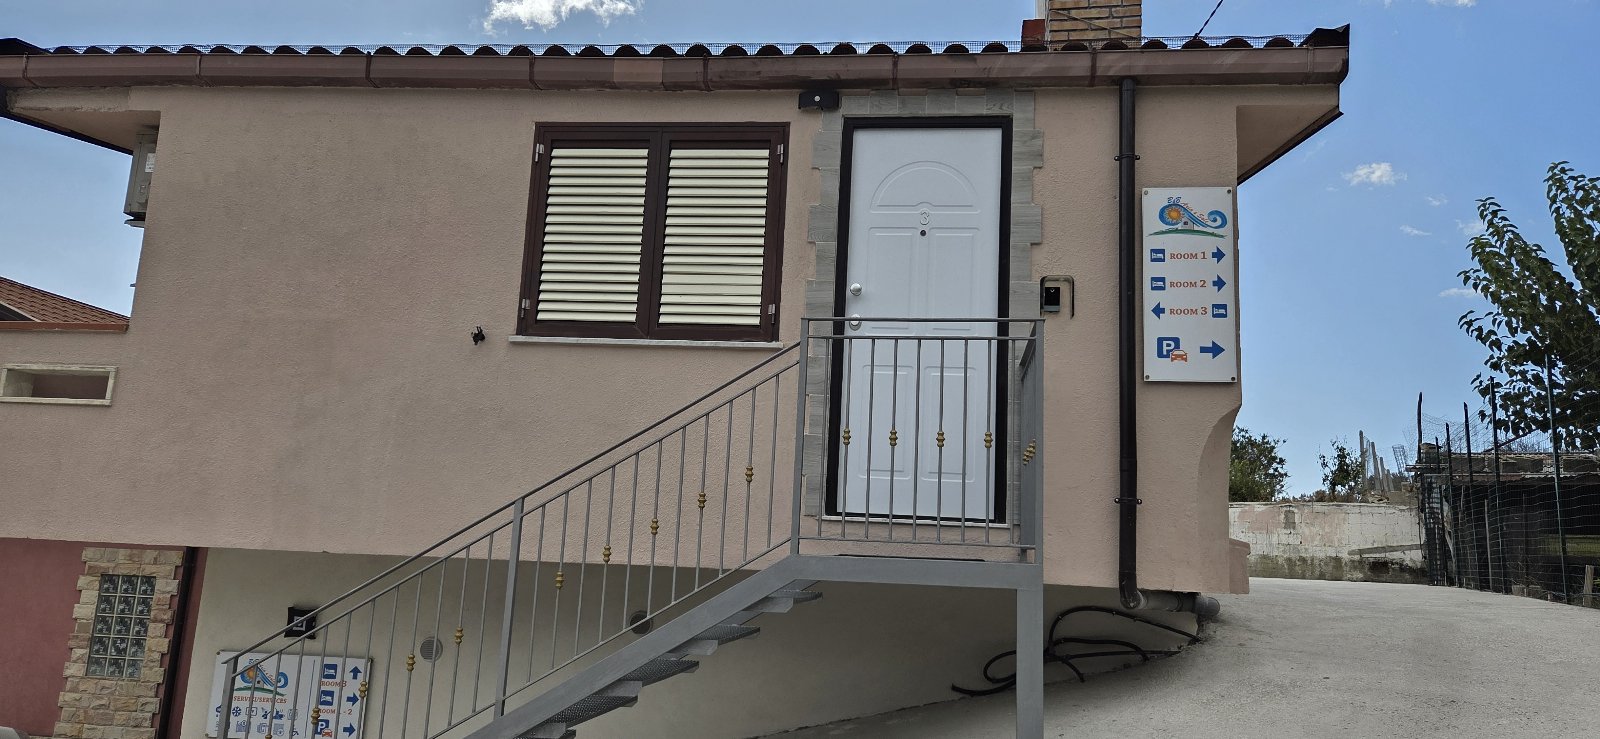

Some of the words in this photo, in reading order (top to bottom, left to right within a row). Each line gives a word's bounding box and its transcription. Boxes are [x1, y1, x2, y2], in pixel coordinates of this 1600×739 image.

[920, 208, 930, 226] 3
[1169, 252, 1198, 260] ROOM
[1200, 251, 1207, 260] 1
[1200, 279, 1207, 288] 2
[1169, 308, 1198, 316] ROOM
[1200, 306, 1208, 316] 3
